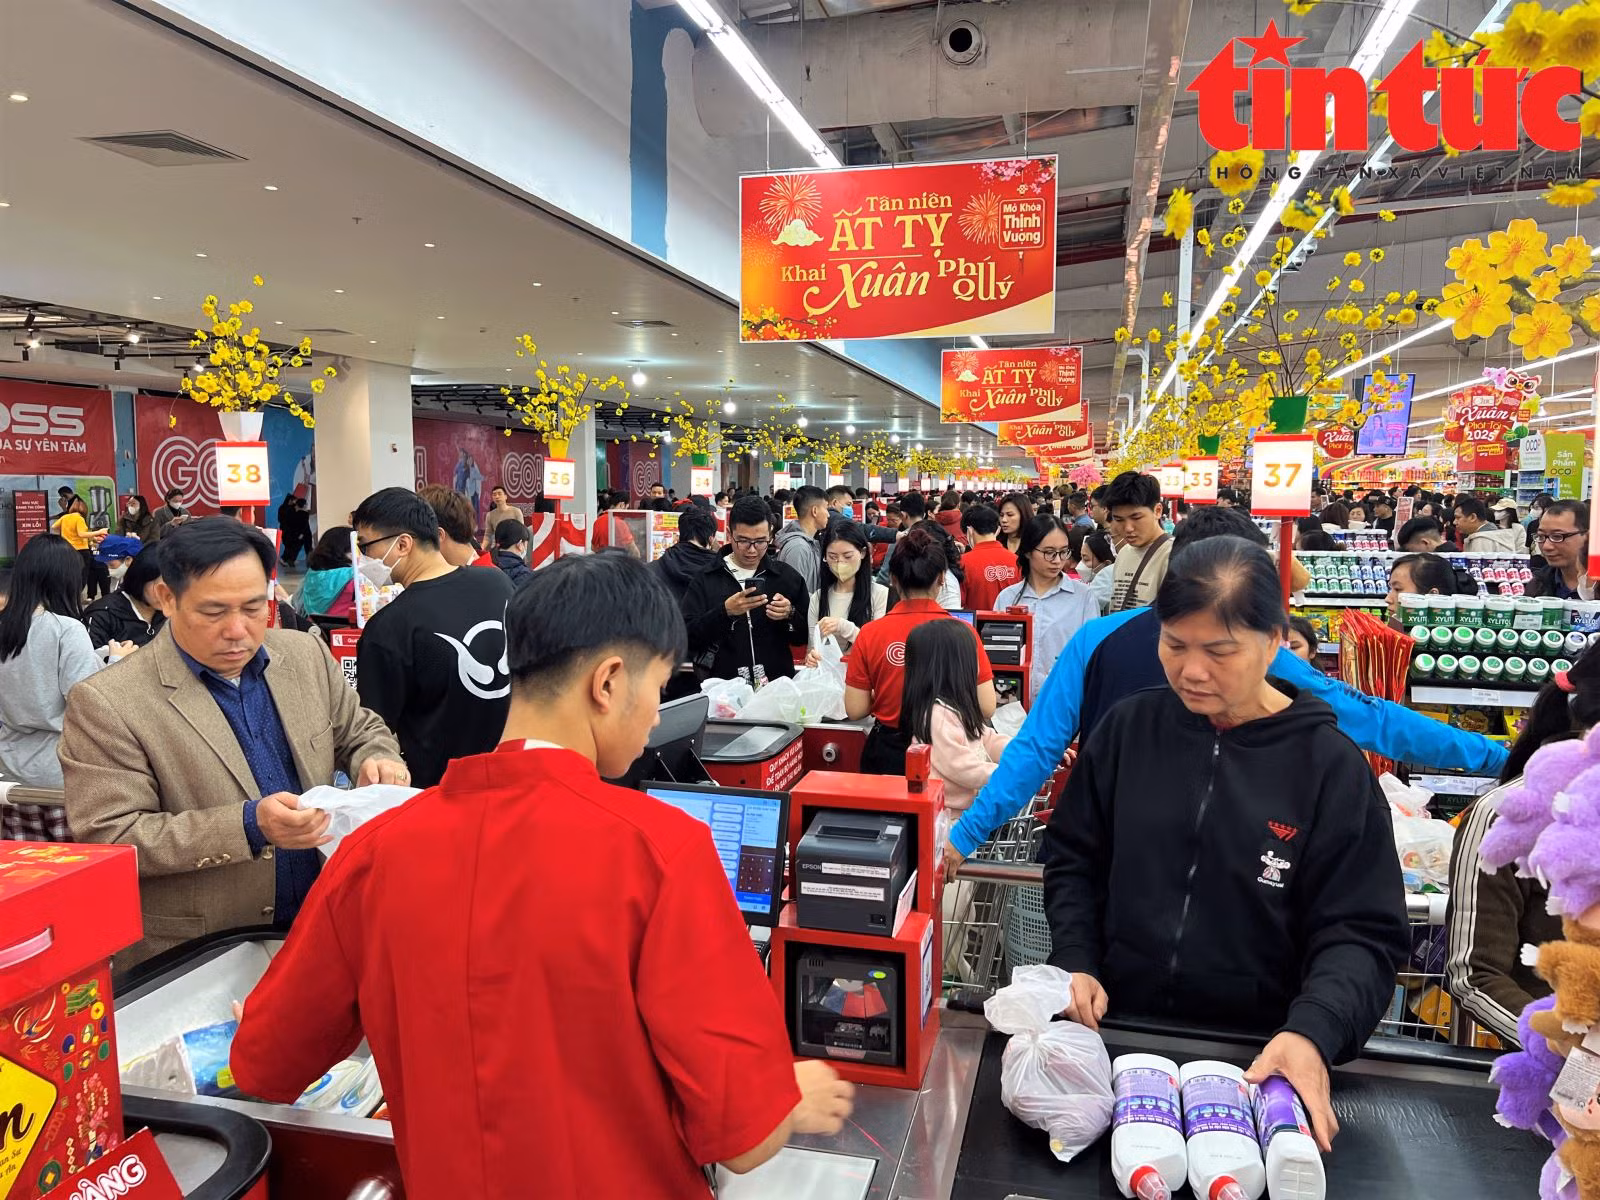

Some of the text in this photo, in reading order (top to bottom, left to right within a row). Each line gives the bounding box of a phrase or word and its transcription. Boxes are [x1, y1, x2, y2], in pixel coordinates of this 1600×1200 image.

[866, 192, 953, 212] Tân niên
[829, 206, 953, 258] ẤT TỴ
[1003, 213, 1041, 232] Thịnh
[780, 263, 827, 283] Khai
[803, 259, 931, 318] Xuân
[959, 389, 981, 398] Khai
[969, 388, 1027, 412] Xuân
[1459, 405, 1509, 426] Xuân
[1466, 429, 1496, 441] 2025
[35, 438, 59, 452] YÊN
[61, 439, 87, 454] TÂM
[226, 463, 262, 484] 38
[549, 471, 571, 486] 36
[1190, 472, 1214, 487] 35
[1264, 463, 1302, 488] 37
[802, 863, 822, 871] EPSON
